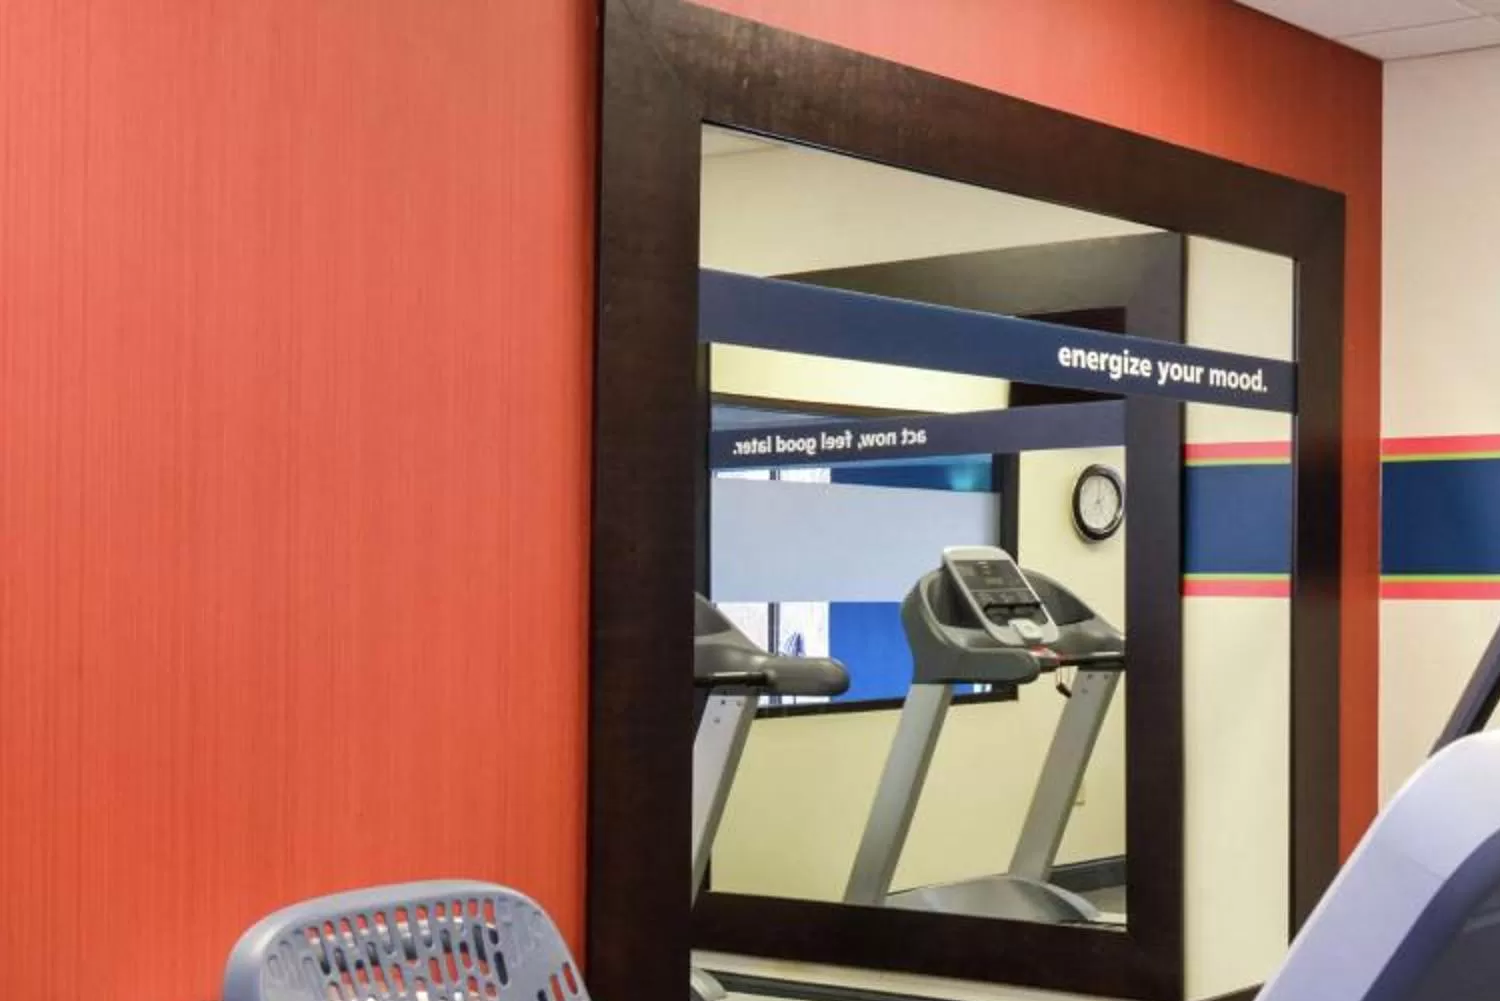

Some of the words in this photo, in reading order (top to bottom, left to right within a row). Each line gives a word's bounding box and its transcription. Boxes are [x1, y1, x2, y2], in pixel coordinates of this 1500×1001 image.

[1058, 346, 1152, 379] energize
[1157, 360, 1204, 385] your
[1209, 369, 1268, 392] mood.
